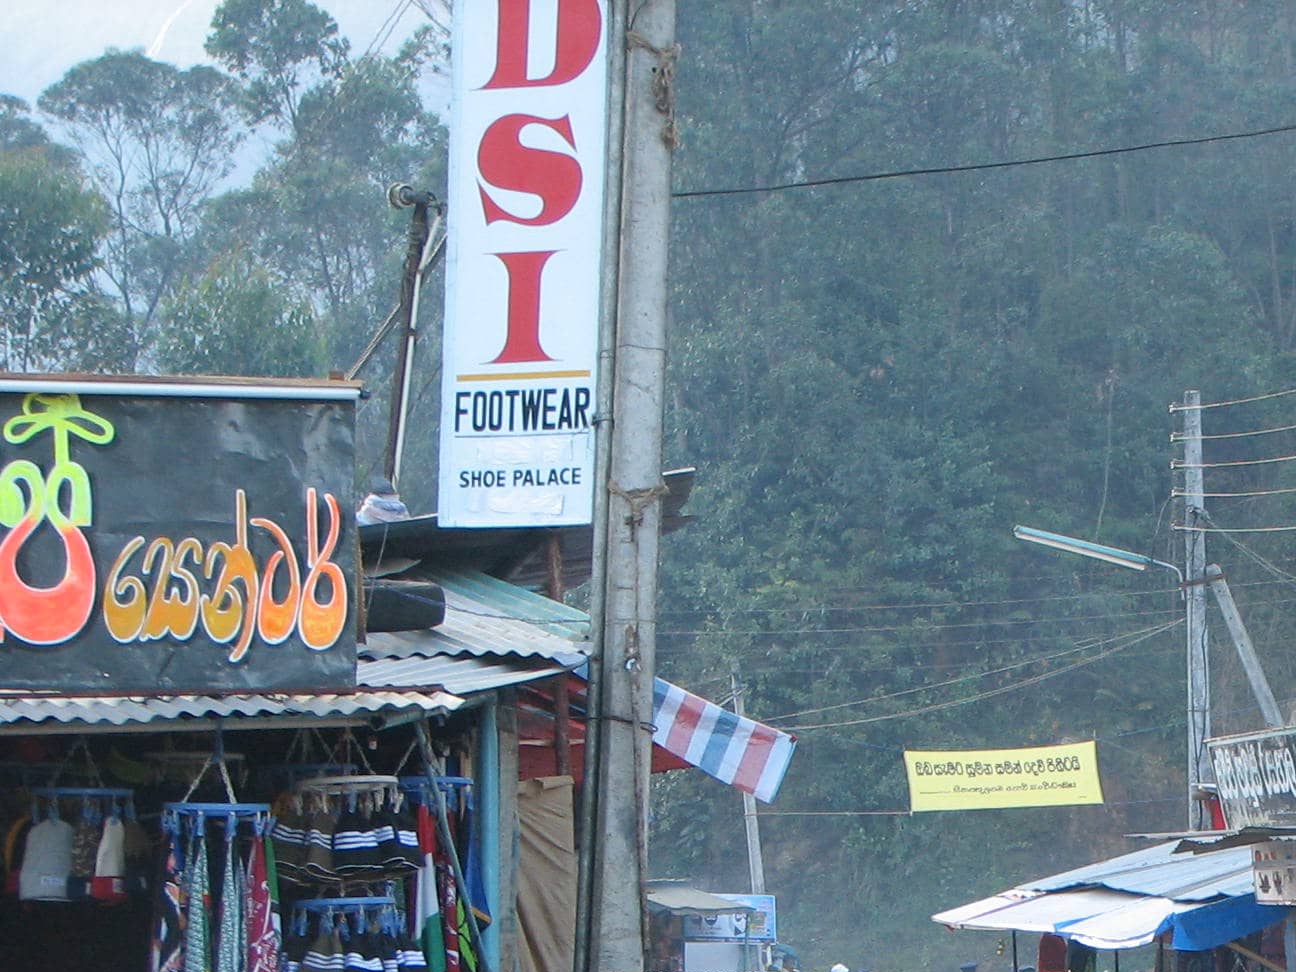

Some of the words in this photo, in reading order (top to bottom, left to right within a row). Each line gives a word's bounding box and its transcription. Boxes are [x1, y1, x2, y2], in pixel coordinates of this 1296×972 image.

[478, 0, 601, 364] DSI
[455, 387, 590, 433] FOOTWEAR
[459, 469, 506, 488] SHOE
[511, 467, 583, 488] PALACE
[103, 487, 348, 662] සෙන්ටර්
